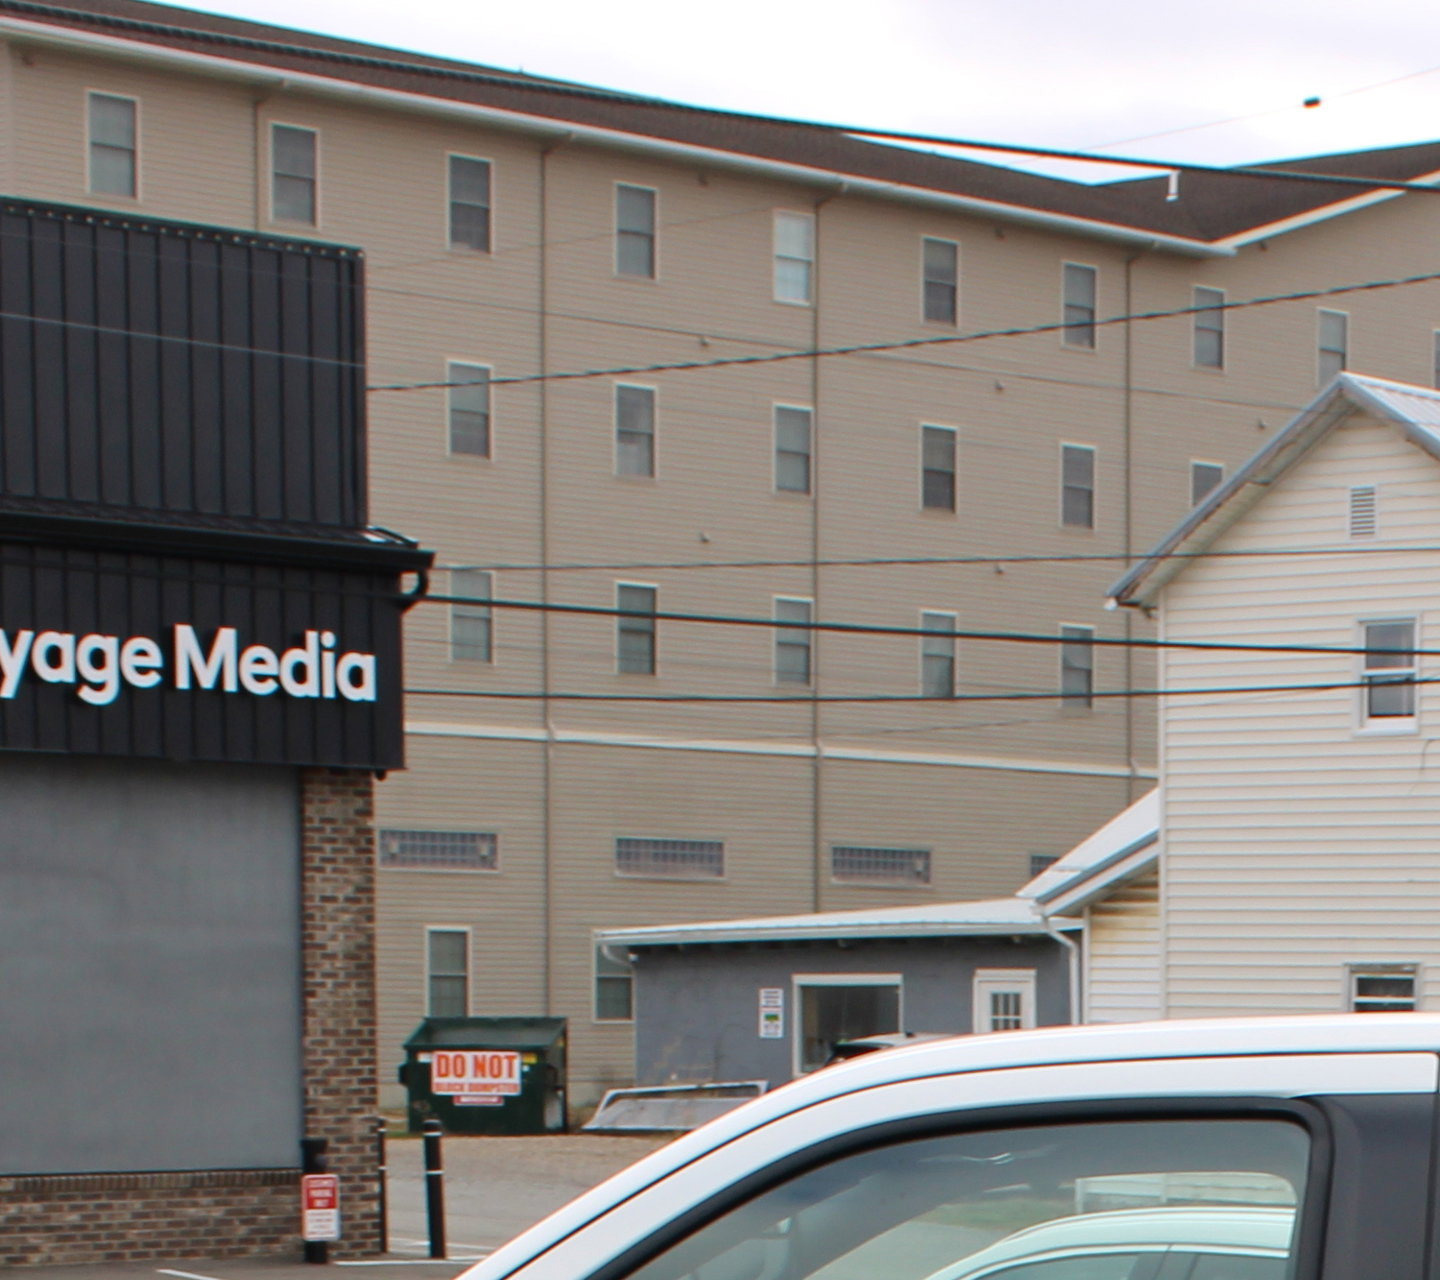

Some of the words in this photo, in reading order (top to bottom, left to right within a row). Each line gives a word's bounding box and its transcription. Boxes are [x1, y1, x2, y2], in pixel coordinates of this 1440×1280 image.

[173, 623, 377, 701] Media
[436, 1053, 466, 1078] DO
[472, 1054, 517, 1079] NOT
